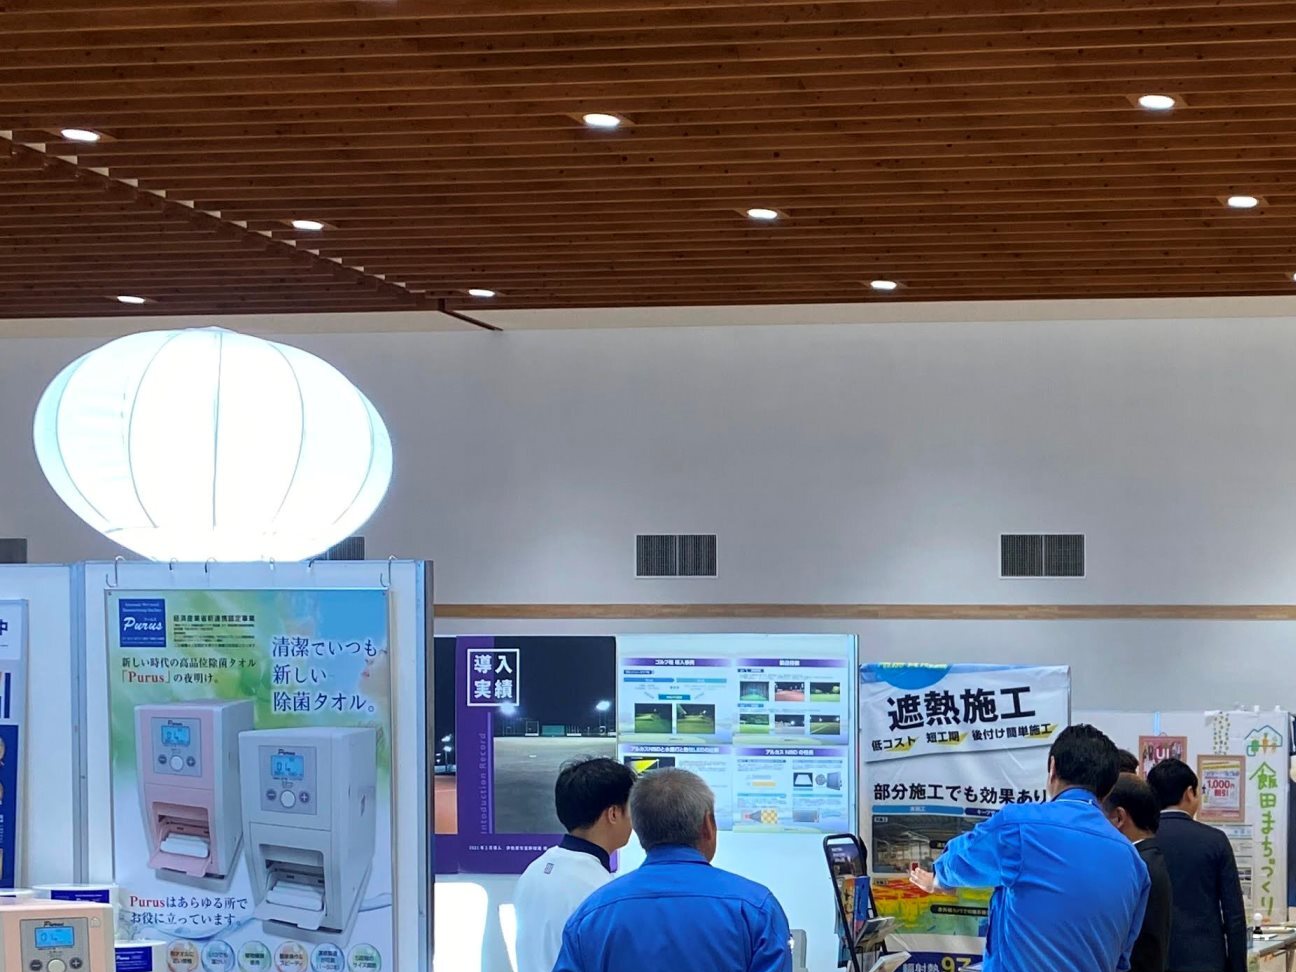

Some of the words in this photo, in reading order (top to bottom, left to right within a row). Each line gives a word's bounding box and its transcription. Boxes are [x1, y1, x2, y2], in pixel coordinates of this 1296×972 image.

[123, 616, 163, 632] Purus
[272, 635, 377, 658] 清潔でいつも
[121, 657, 257, 669] 新しい時代の高品位除菌タオル
[473, 654, 514, 675] 導入
[273, 663, 328, 685] 新しい
[473, 679, 514, 700] 実績
[273, 690, 376, 713] 除菌タオル。
[886, 685, 1036, 732] 遮熱施工
[871, 735, 917, 752] 低コスト
[926, 730, 961, 744] 短工期
[971, 723, 1053, 741] 後付け簡単施工
[873, 783, 1048, 804] 部分施工でも効果あり
[1249, 762, 1279, 917] 飯田まちづくり
[129, 895, 249, 910] Purusはあらゆる所で
[130, 911, 242, 926] お役に立っています。
